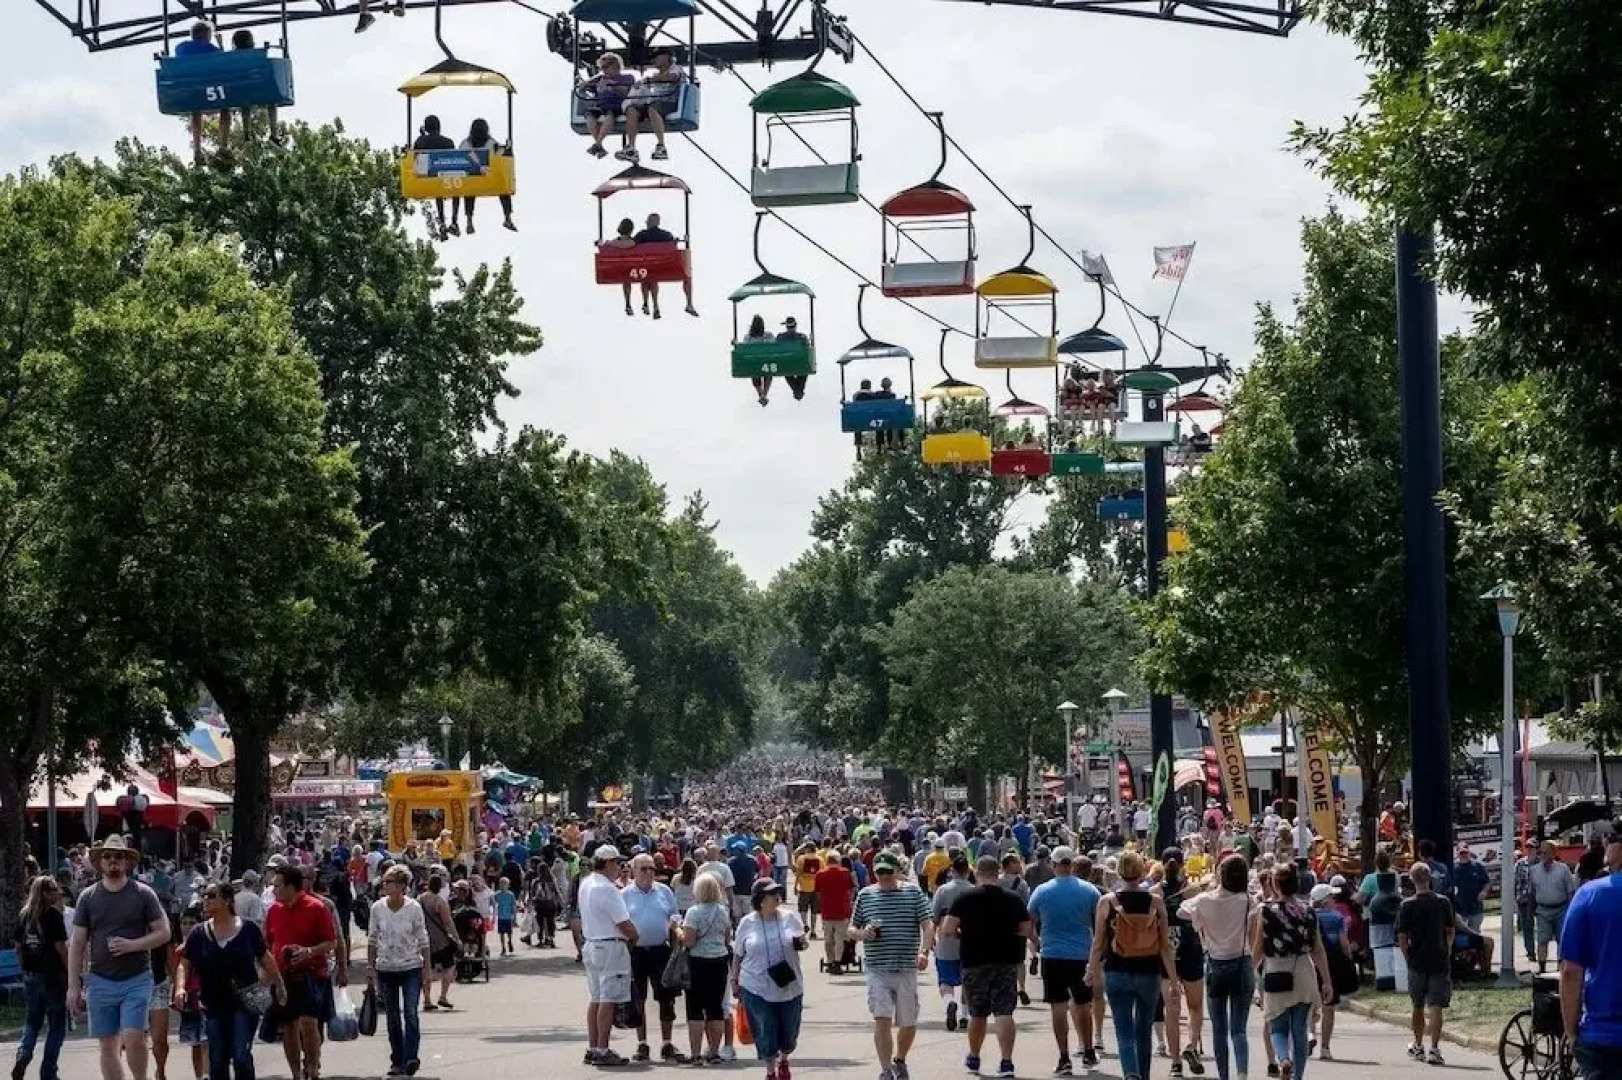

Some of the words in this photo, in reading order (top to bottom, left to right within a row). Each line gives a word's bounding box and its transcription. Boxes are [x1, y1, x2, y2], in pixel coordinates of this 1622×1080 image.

[206, 85, 226, 101] 51
[443, 178, 463, 189] 50
[630, 268, 648, 279] 49
[1217, 712, 1245, 800] WELCOME
[1305, 733, 1329, 812] ELCOME
